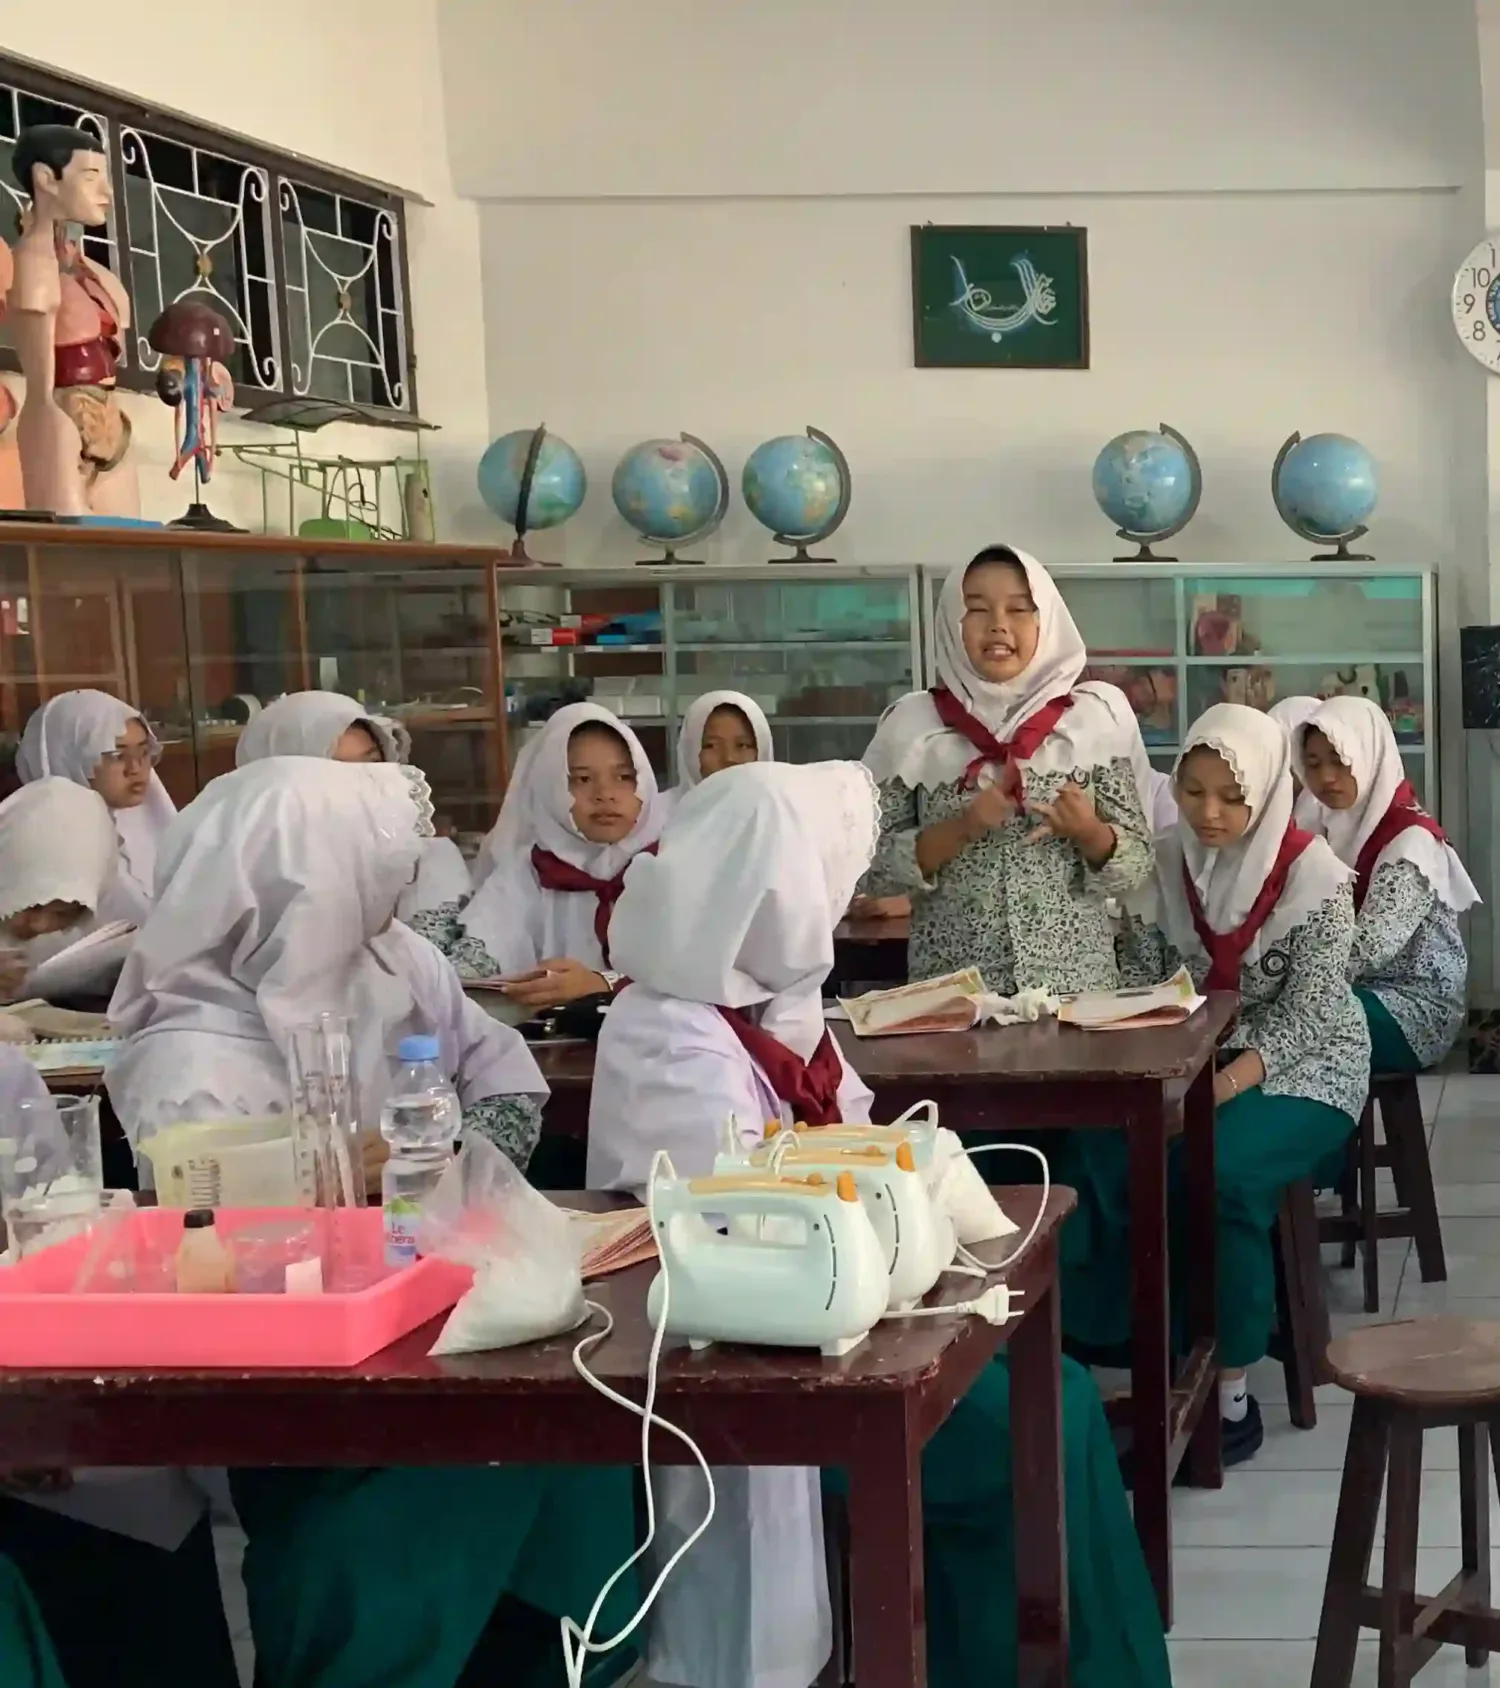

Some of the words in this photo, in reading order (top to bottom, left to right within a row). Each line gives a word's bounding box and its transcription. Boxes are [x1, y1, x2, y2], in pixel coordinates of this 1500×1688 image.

[1472, 267, 1491, 288] 10
[1463, 293, 1476, 315] 9
[1472, 320, 1486, 342] 8
